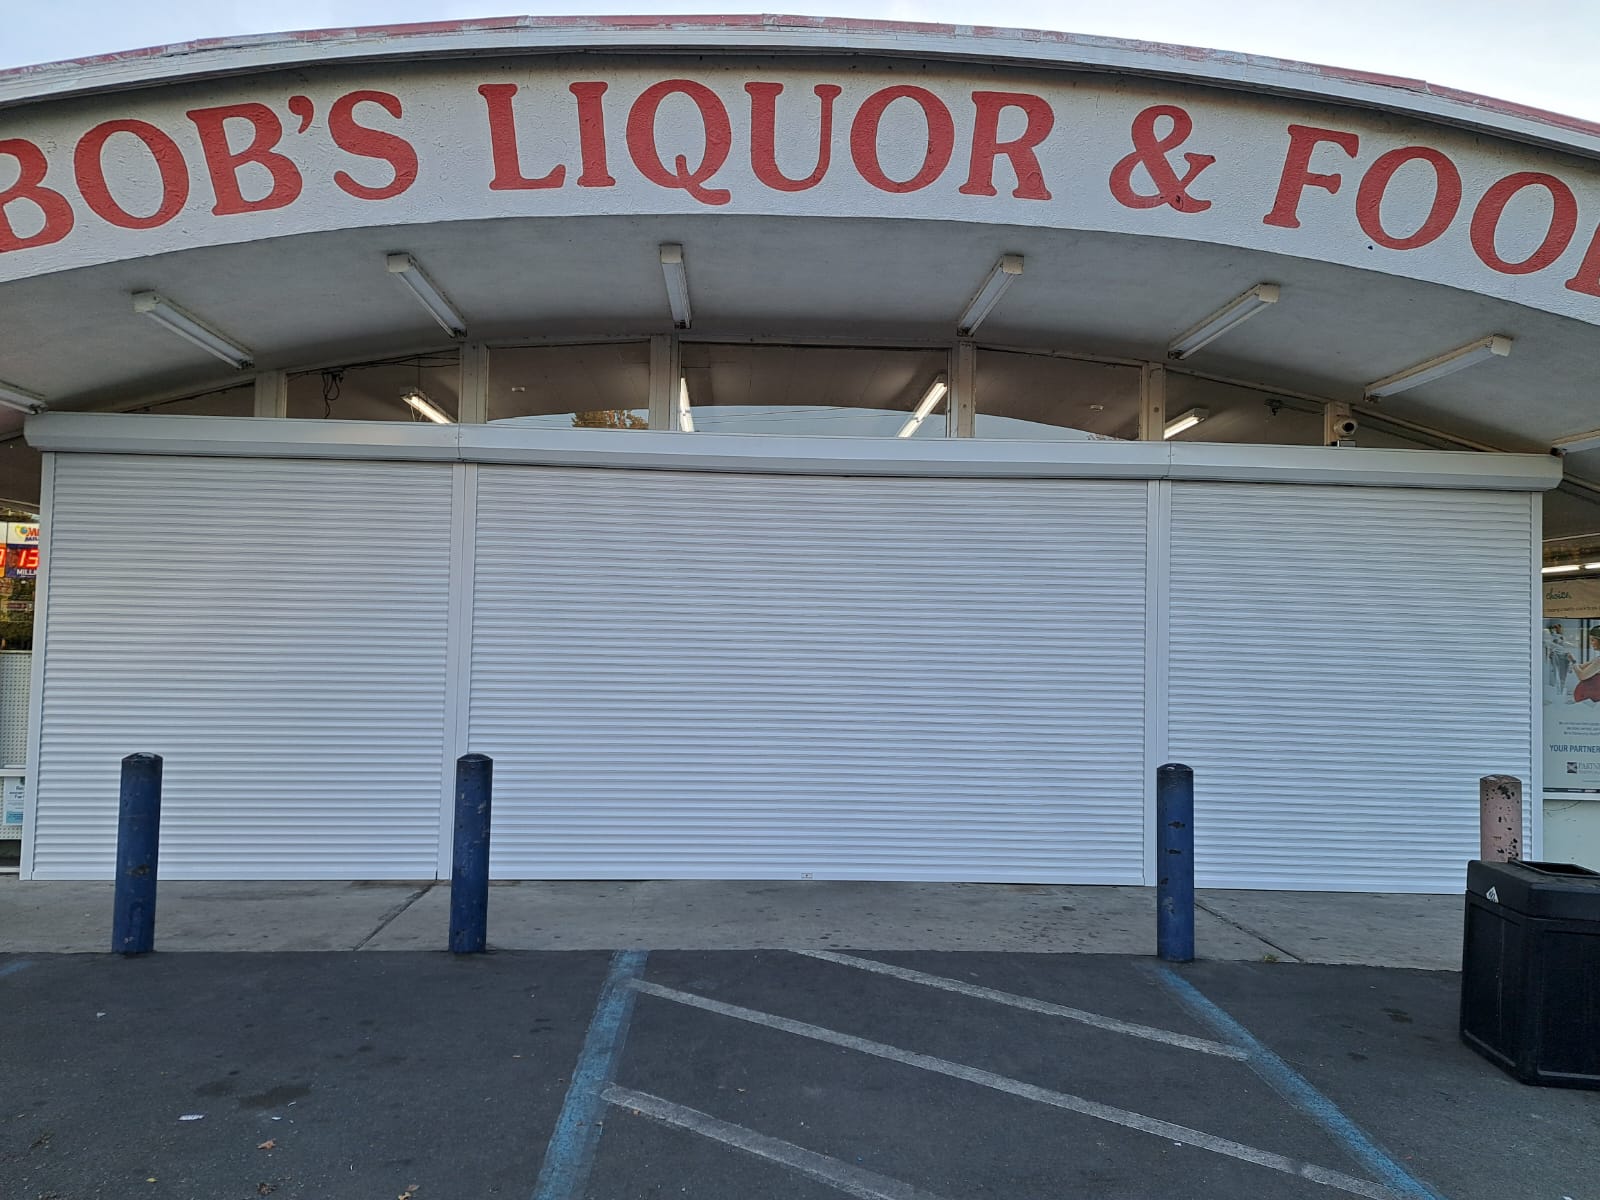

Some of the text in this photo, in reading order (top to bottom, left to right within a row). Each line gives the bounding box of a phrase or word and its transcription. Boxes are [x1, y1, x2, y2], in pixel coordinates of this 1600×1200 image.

[0, 90, 418, 253] BOB'S
[478, 79, 1053, 206] LIQUOR
[1108, 104, 1216, 214] &
[1549, 744, 1568, 753] YOUR
